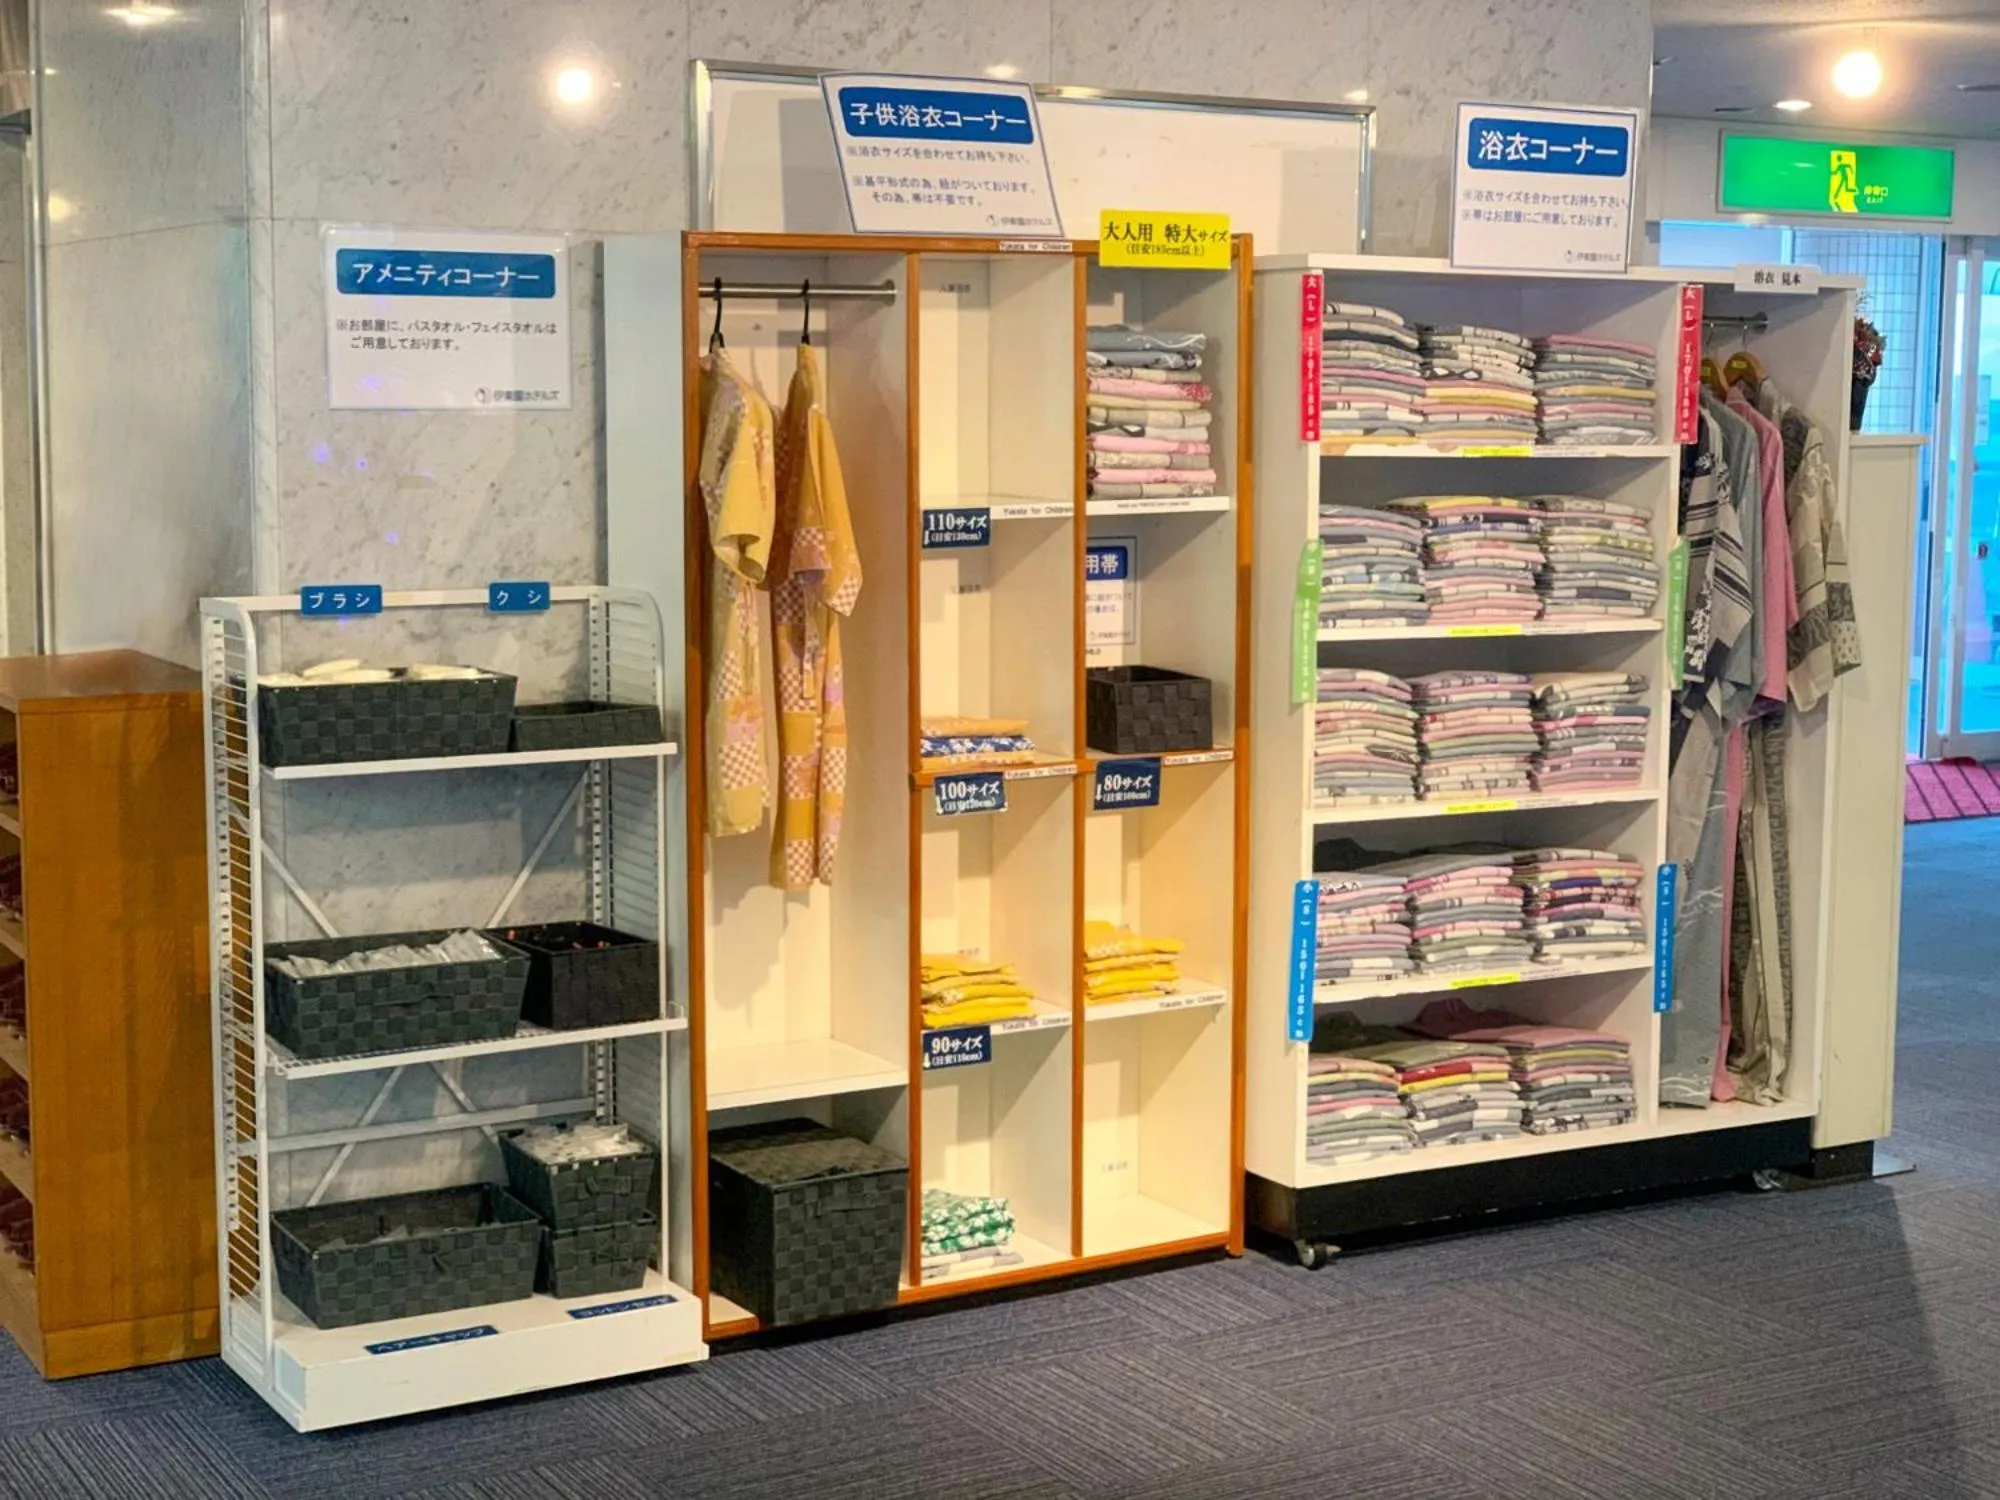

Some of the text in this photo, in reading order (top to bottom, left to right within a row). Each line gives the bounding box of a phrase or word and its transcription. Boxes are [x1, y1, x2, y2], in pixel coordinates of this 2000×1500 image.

[850, 102, 1026, 131] 子供浴衣コーナー
[1478, 130, 1619, 165] 浴衣コーナー
[1103, 221, 1229, 243] 大人用 特大サイズ
[352, 262, 541, 288] アメニティコーナー
[1753, 271, 1802, 285] 浴衣 見本
[350, 336, 460, 352] ご用意しております。
[928, 513, 988, 532] 110サイズ
[309, 592, 370, 609] ブラシ
[939, 780, 1000, 801] 100サイズ
[1103, 773, 1153, 791] 80サイズ
[931, 1035, 984, 1054] 90サイズ
